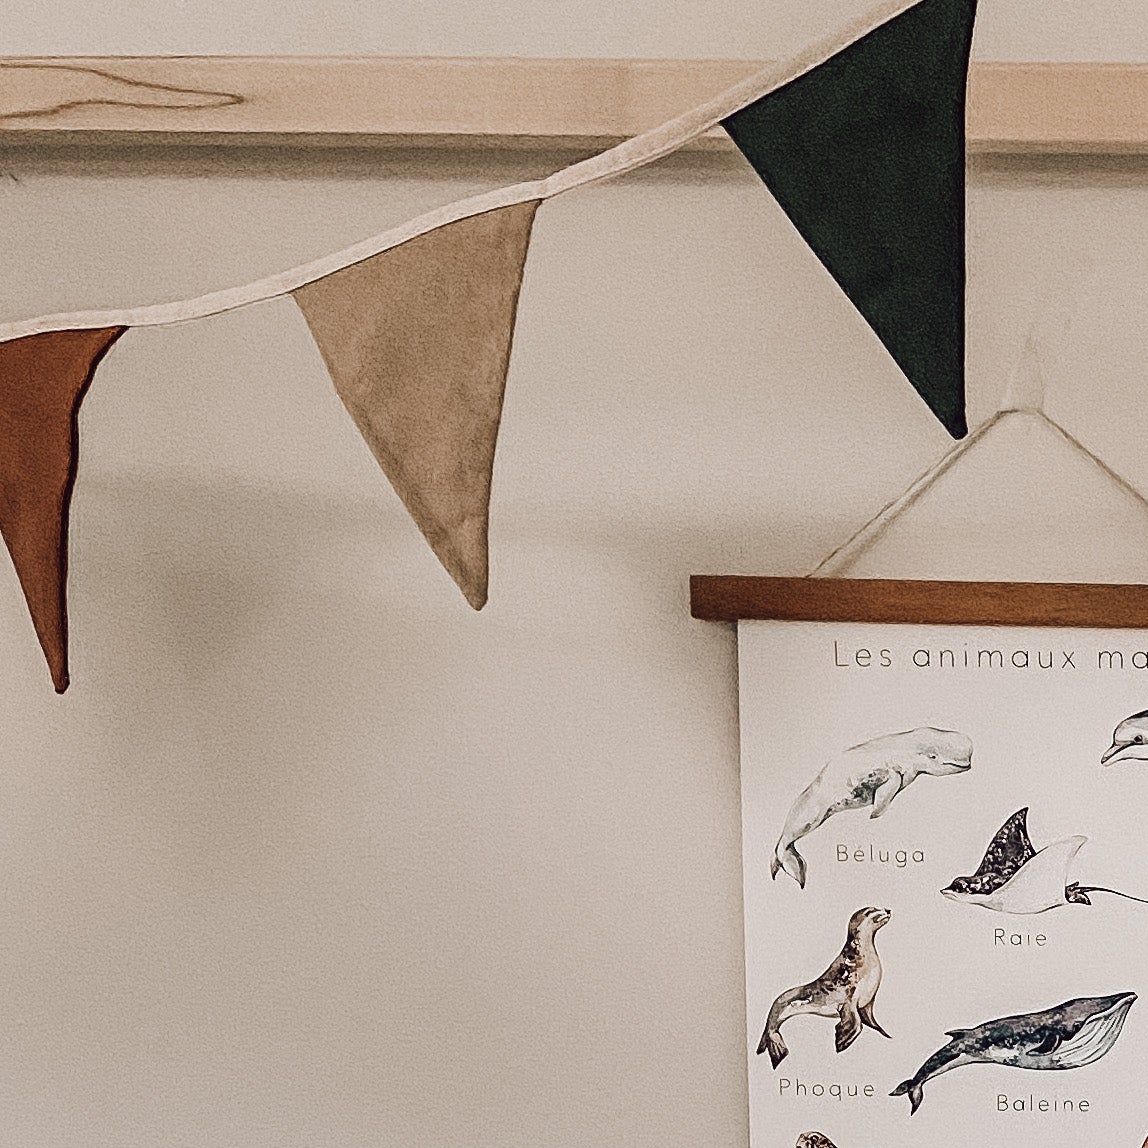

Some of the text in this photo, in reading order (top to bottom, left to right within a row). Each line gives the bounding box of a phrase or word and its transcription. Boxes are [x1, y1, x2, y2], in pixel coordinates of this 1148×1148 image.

[833, 639, 892, 668] Les
[912, 642, 1076, 670] animaux
[836, 843, 925, 869] Béluga
[994, 927, 1047, 947] Raie
[779, 1077, 875, 1102] Phoque
[996, 1093, 1090, 1113] Baleine
